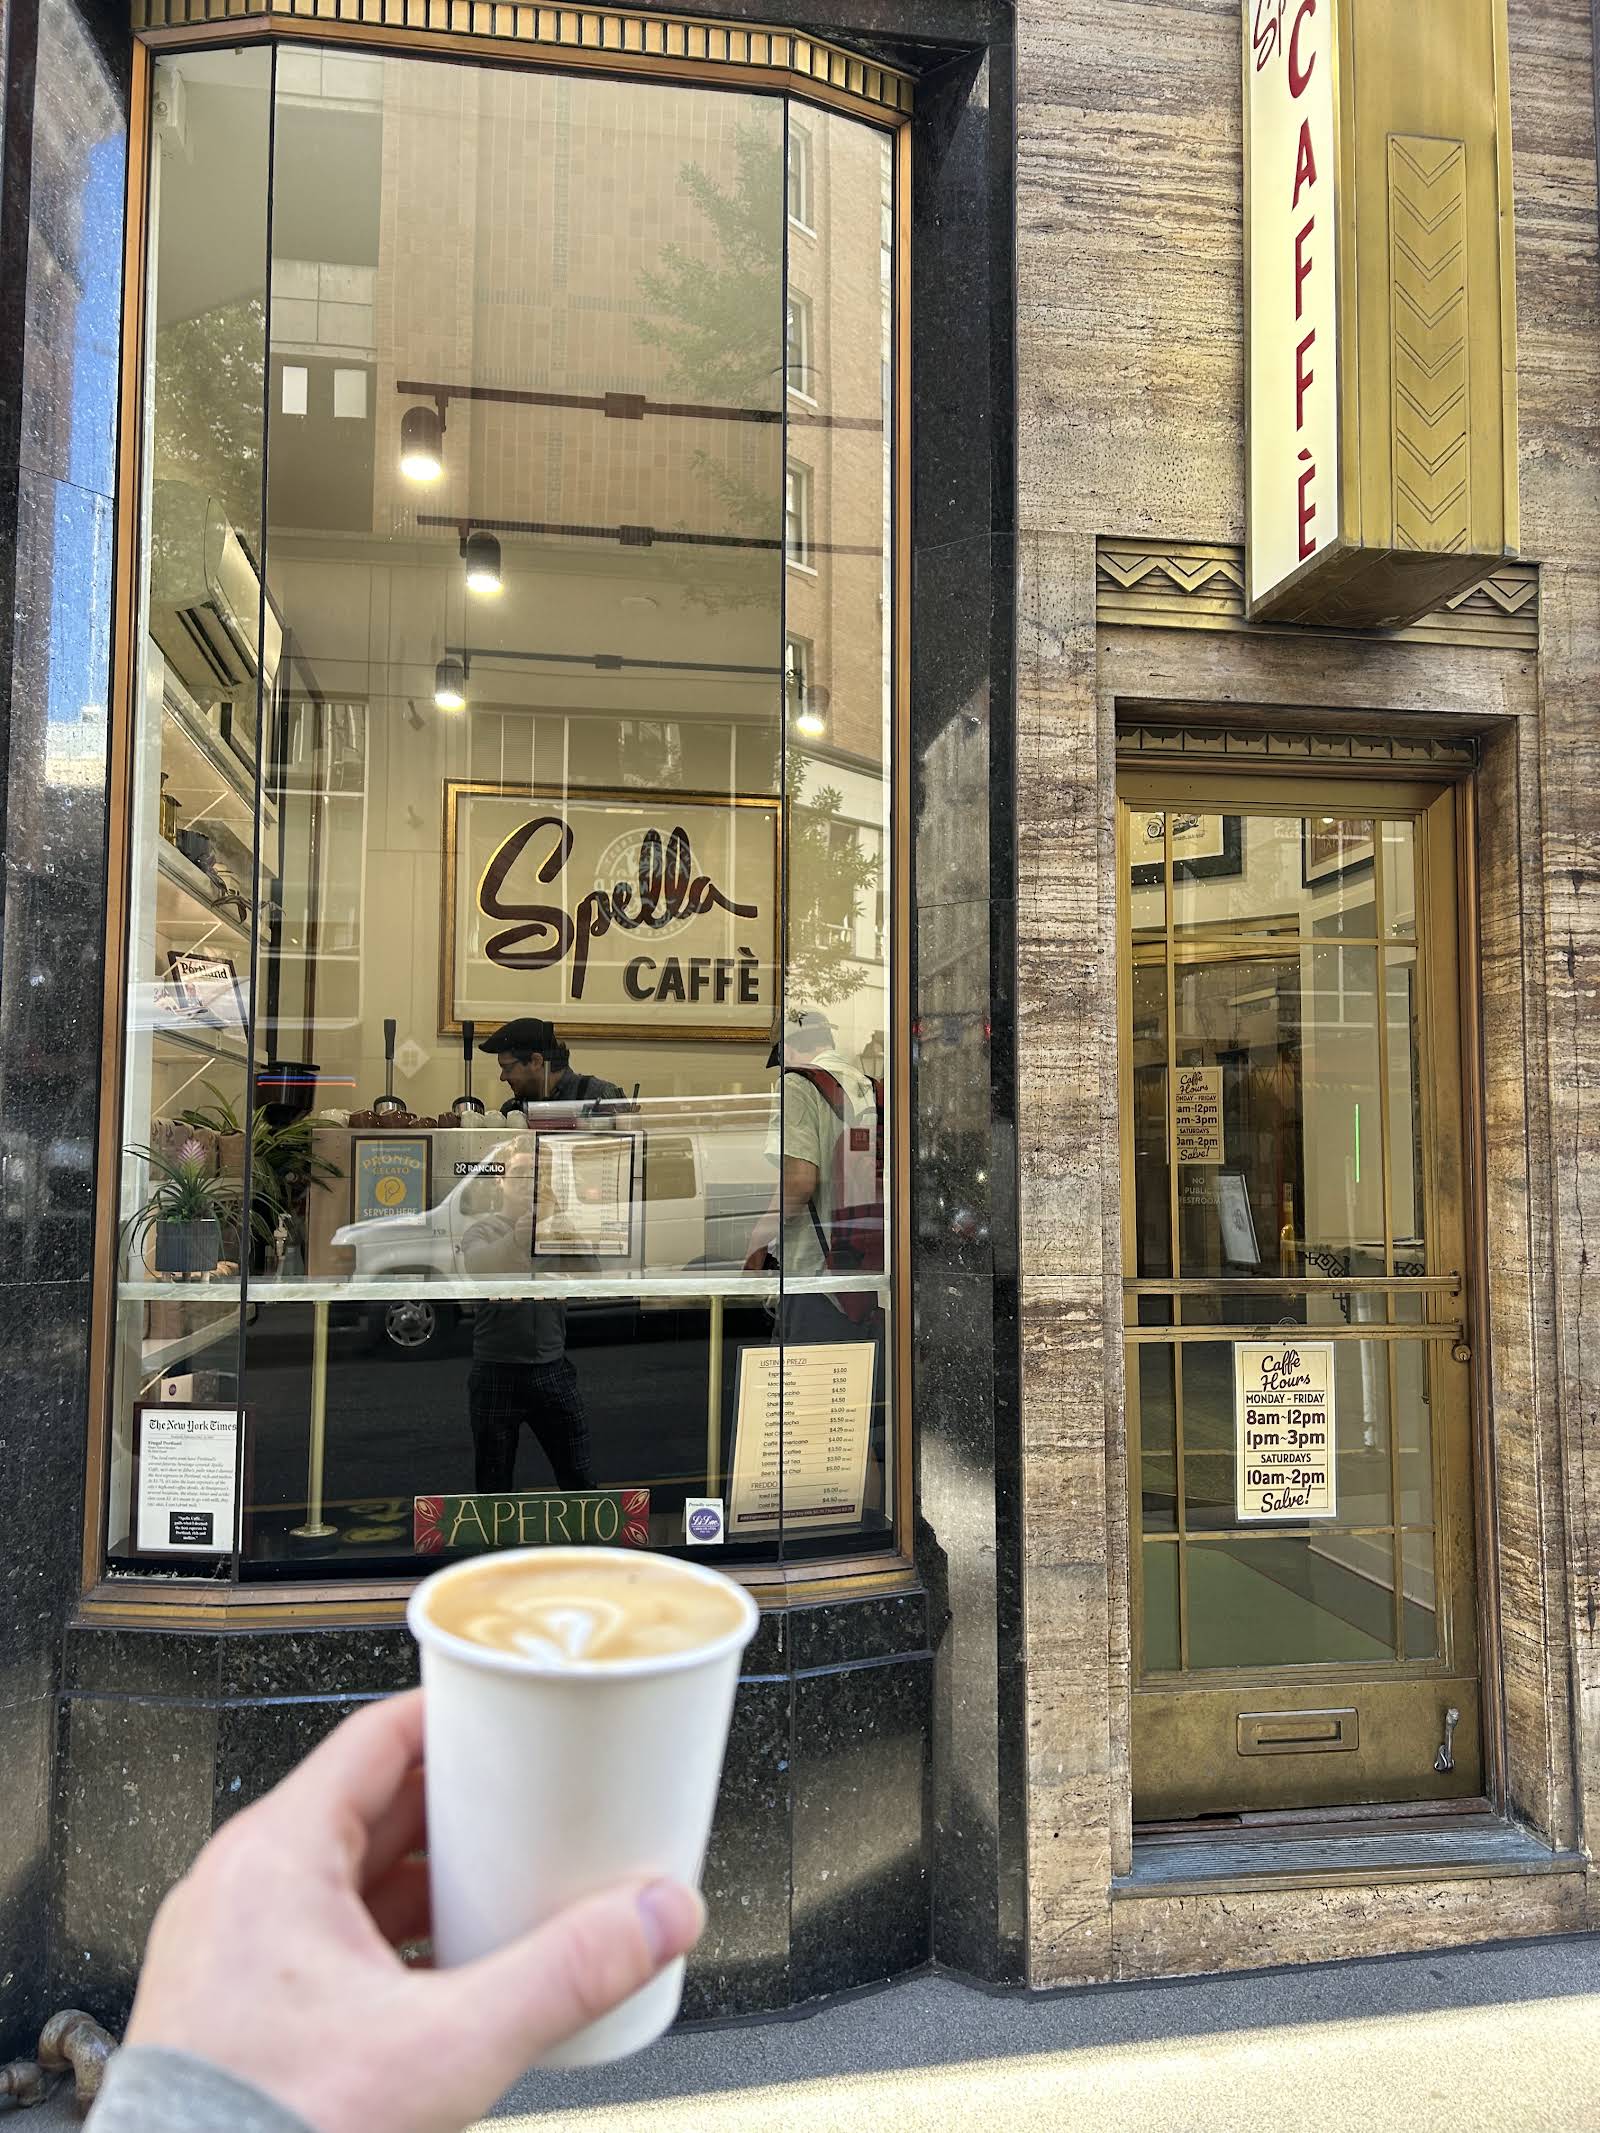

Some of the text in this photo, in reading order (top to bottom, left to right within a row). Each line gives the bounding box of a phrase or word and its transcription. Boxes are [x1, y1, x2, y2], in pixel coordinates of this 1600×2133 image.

[1288, 0, 1317, 562] CAFFÈ
[478, 816, 759, 999] Spella
[624, 946, 759, 1003] CAFFÈ
[1180, 1084, 1208, 1095] Hours
[1180, 1146, 1210, 1161] Salve!
[373, 1167, 410, 1175] GELATO
[467, 1164, 505, 1173] RANCILIO
[1184, 1186, 1211, 1195] PUBLIC
[363, 1208, 418, 1217] SERVED HERE
[1261, 1349, 1301, 1375] Caffè
[1261, 1373, 1311, 1392] Hours
[1246, 1393, 1285, 1404] MONDAY
[1293, 1393, 1324, 1404] FRIDAY
[149, 1419, 237, 1432] The New York Times
[1261, 1453, 1311, 1463] SATURDAYS
[750, 1481, 778, 1489] FREDDO
[1261, 1485, 1312, 1513] Salve!
[448, 1498, 619, 1546] APERTO
